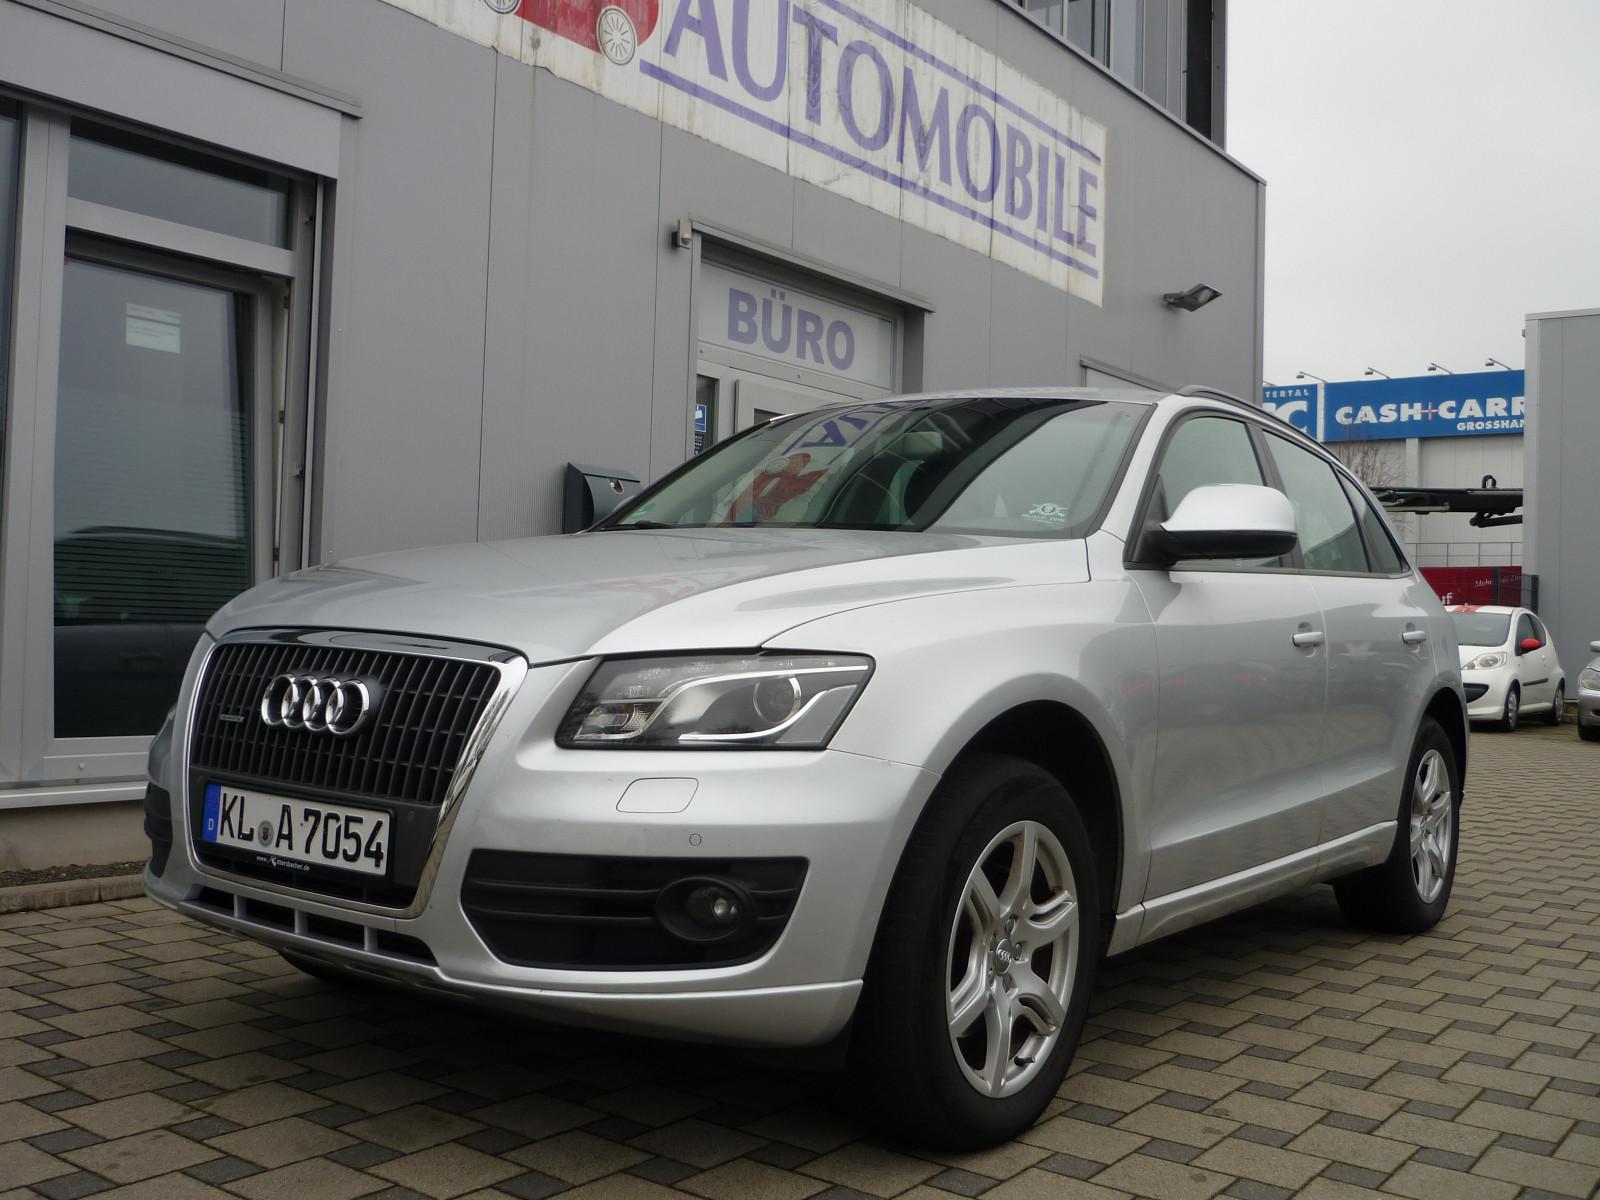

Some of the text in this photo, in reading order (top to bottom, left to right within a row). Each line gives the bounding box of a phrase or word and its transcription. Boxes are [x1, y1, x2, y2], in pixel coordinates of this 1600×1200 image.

[663, 0, 1098, 257] AUTOMOBILE
[728, 287, 855, 371] BÜRO
[220, 793, 254, 842] KL
